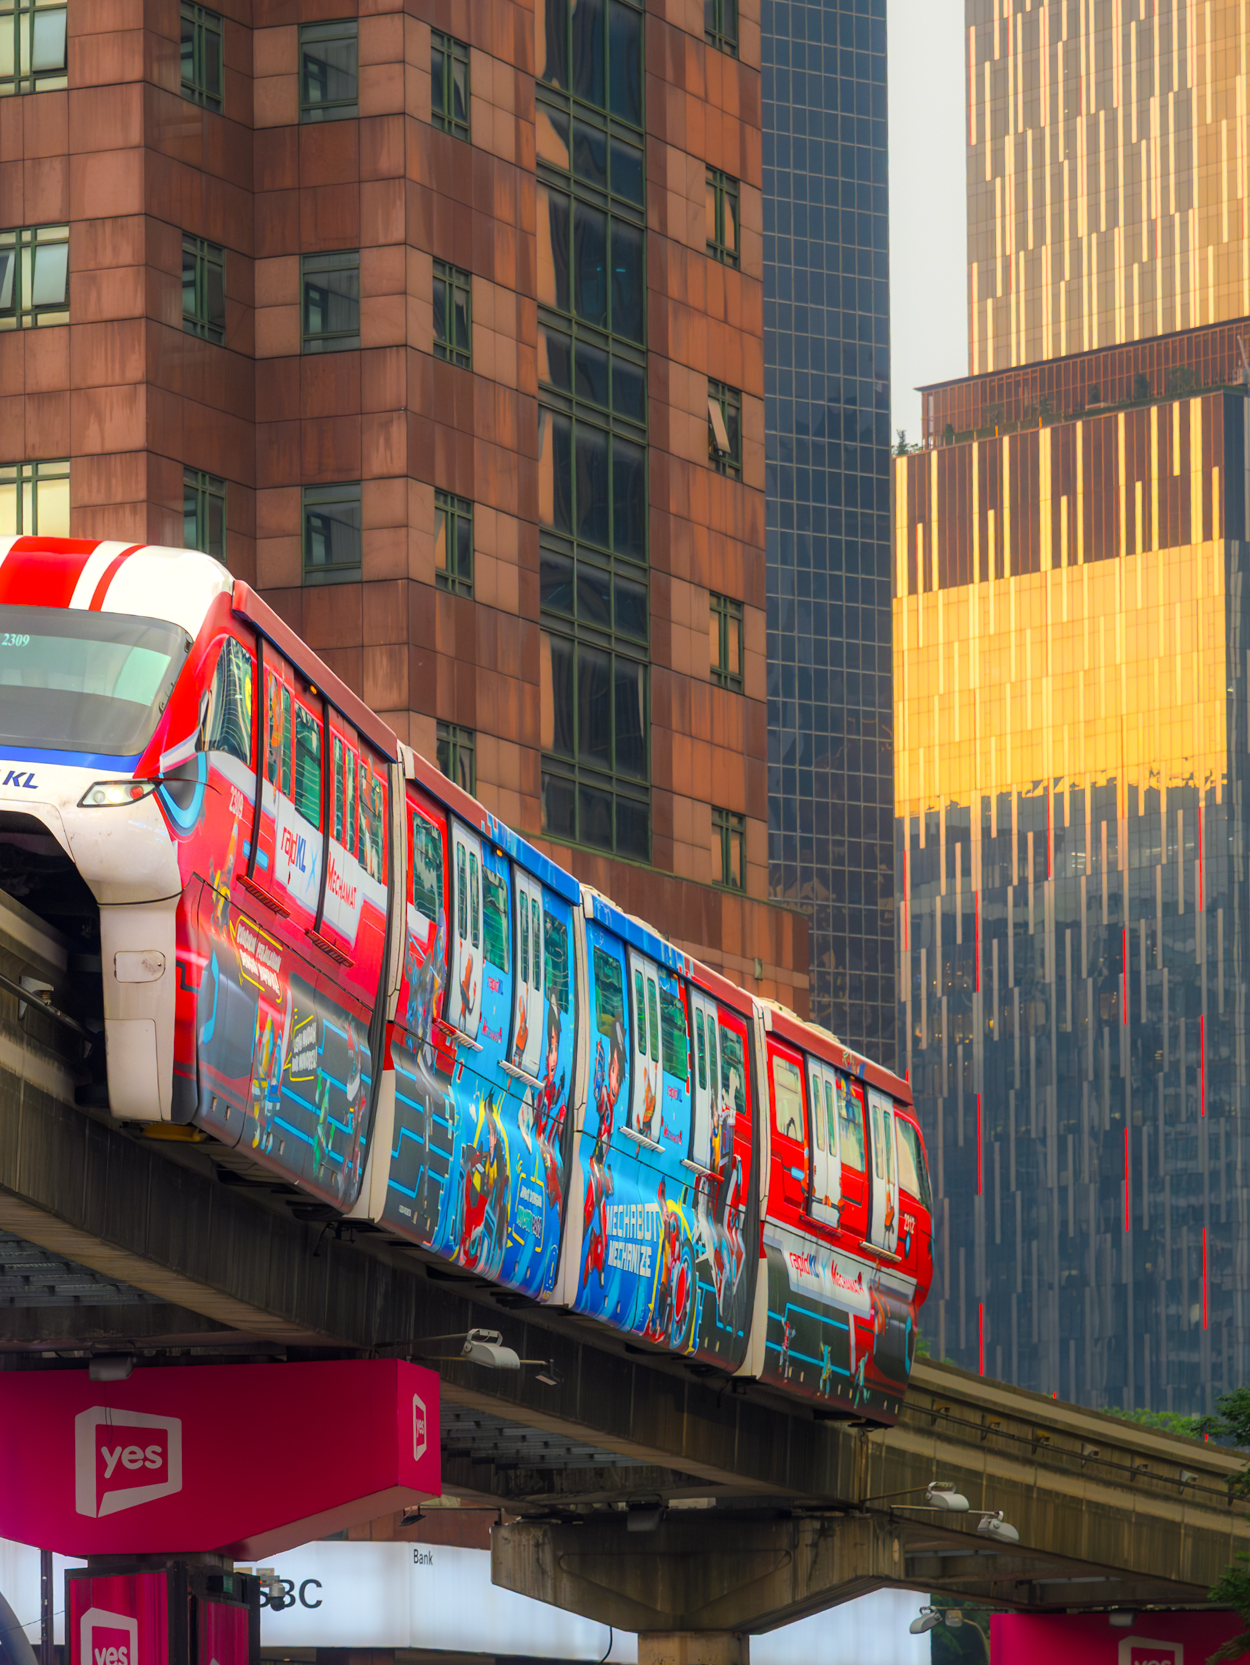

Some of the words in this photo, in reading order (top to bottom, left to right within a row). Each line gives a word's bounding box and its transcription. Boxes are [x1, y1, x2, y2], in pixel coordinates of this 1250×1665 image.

[2, 633, 30, 647] 2309
[607, 1202, 659, 1242] MECHABOT
[608, 1239, 652, 1278] MECHANIZE
[101, 1445, 163, 1479] yes
[413, 1548, 433, 1567] Bank
